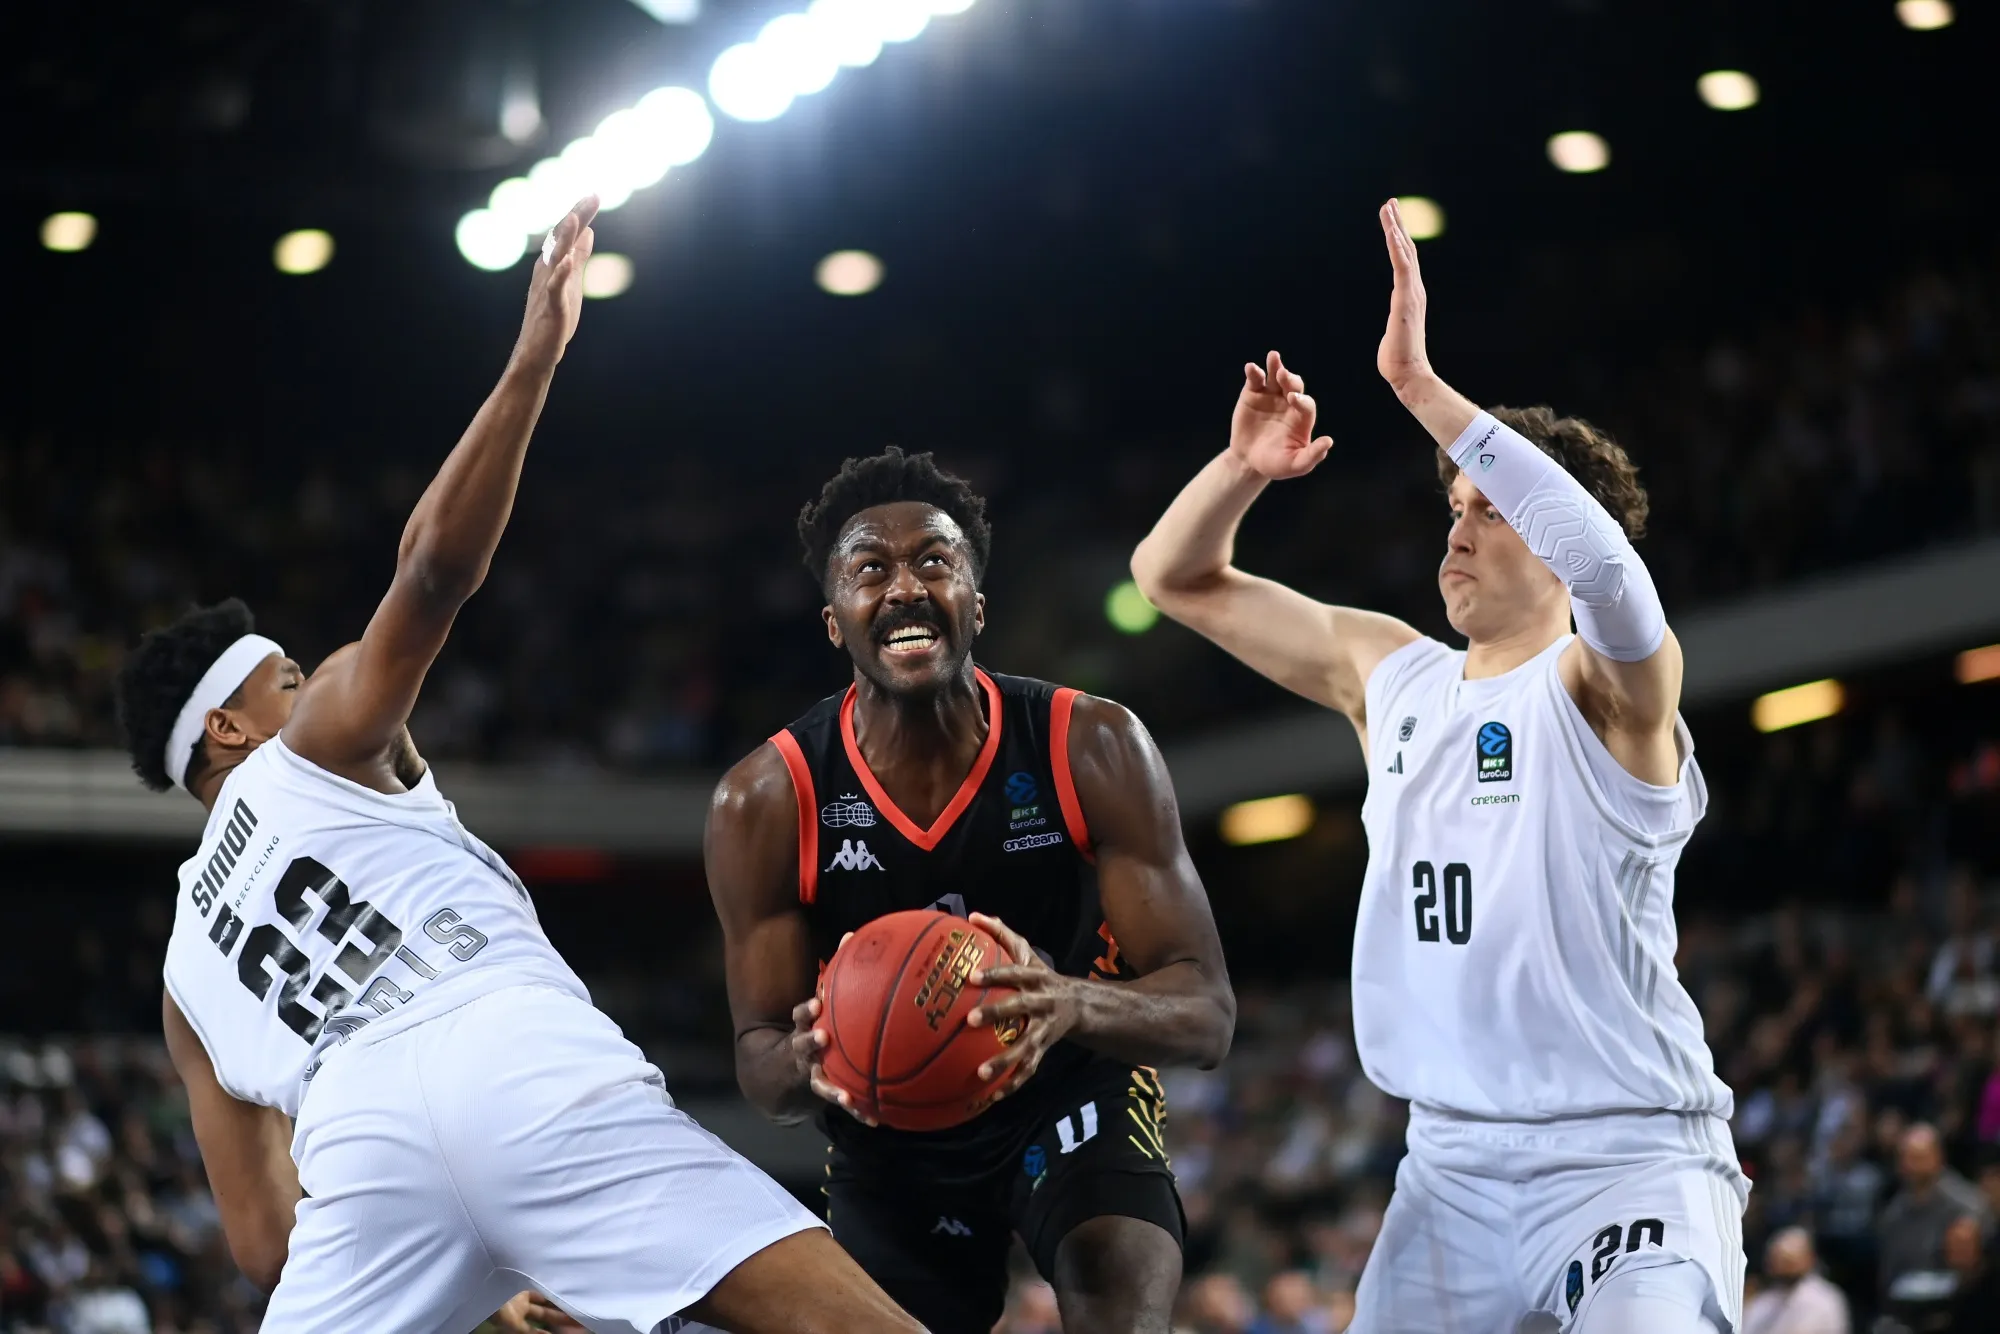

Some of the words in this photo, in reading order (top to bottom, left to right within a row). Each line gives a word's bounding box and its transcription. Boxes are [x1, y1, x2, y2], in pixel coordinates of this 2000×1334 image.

[1479, 769, 1510, 780] EuroCup
[1471, 793, 1521, 806] oneteam
[1003, 832, 1063, 852] oneteam
[1009, 817, 1047, 830] EuroCup
[191, 797, 259, 918] SIMON
[235, 835, 280, 909] RECYCLING
[1412, 861, 1473, 945] 20
[238, 856, 402, 1047] 23
